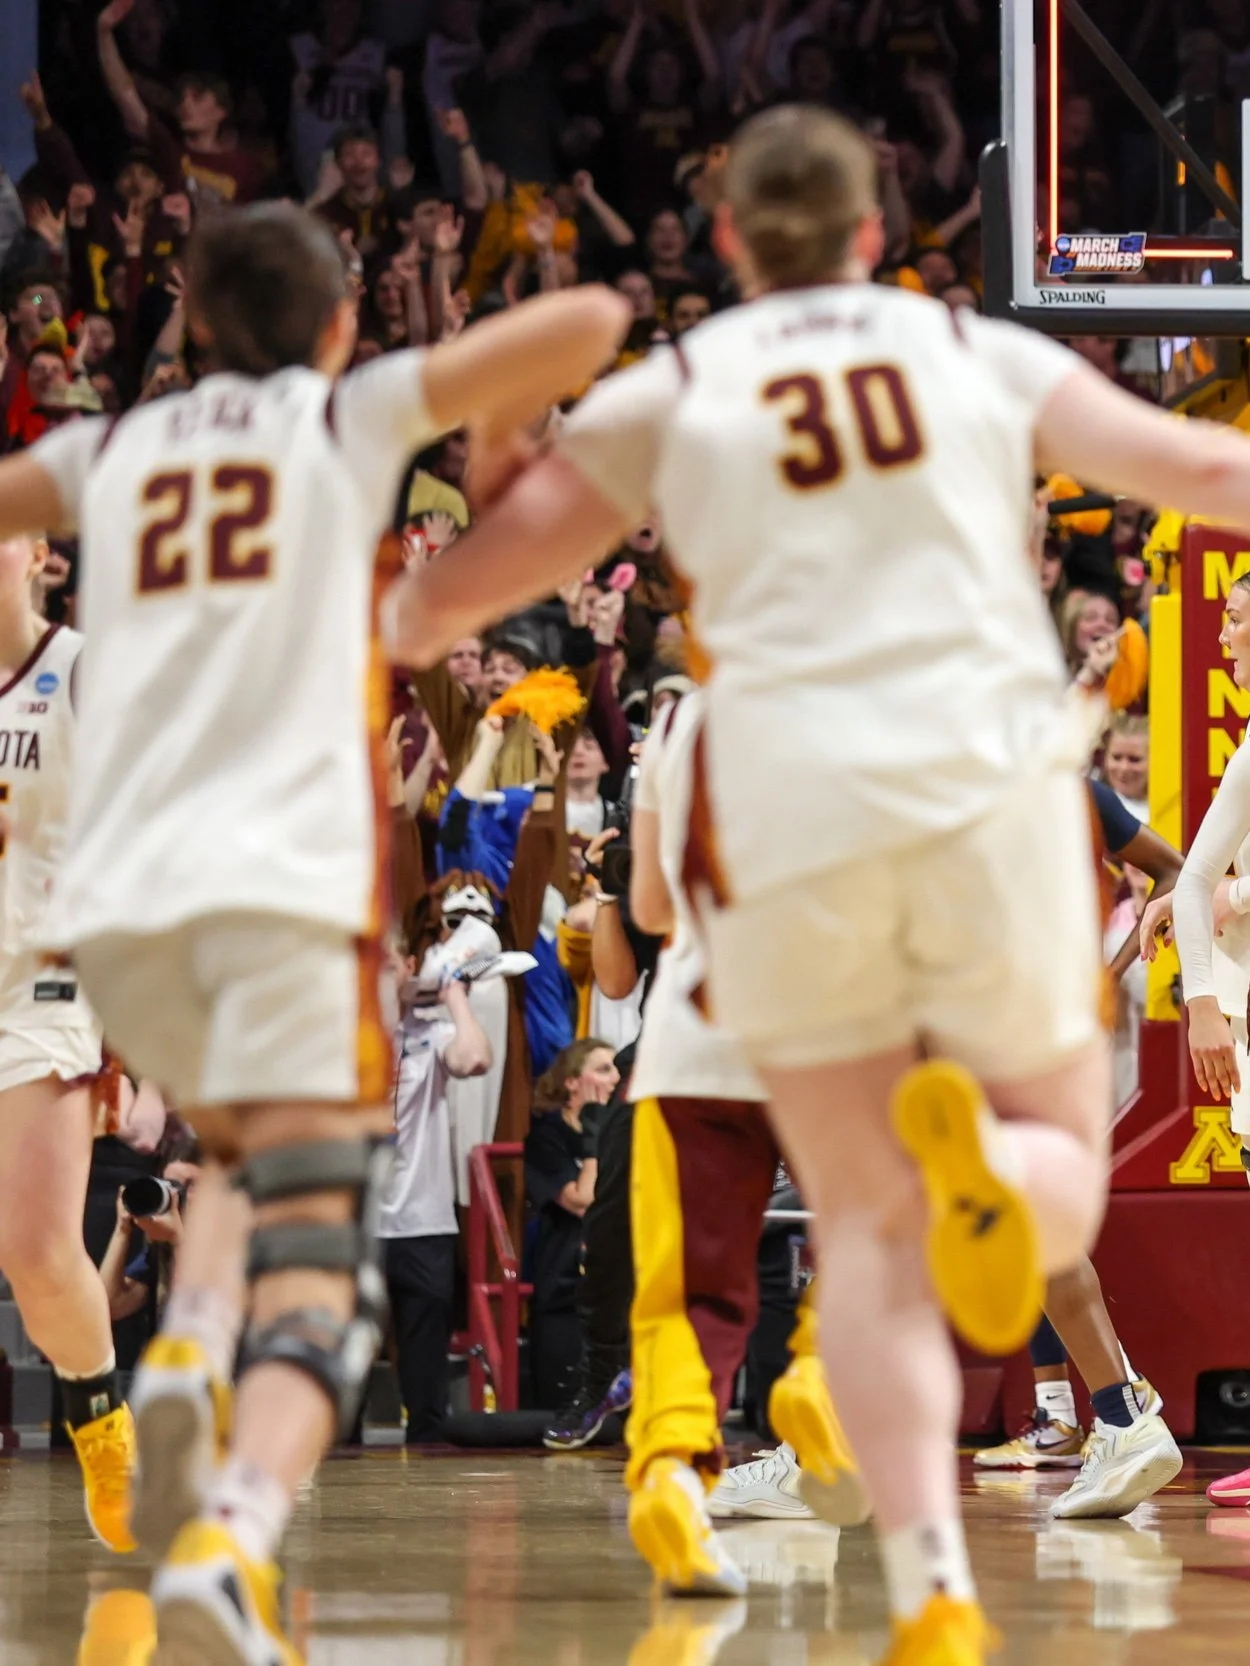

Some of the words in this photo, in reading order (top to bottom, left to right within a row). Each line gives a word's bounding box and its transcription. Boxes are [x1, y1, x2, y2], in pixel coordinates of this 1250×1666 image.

[1070, 238, 1119, 252] MARCH
[1076, 252, 1142, 267] MADNESS
[1039, 289, 1106, 304] SPALDING
[762, 364, 926, 490] 30
[136, 463, 276, 595] 22
